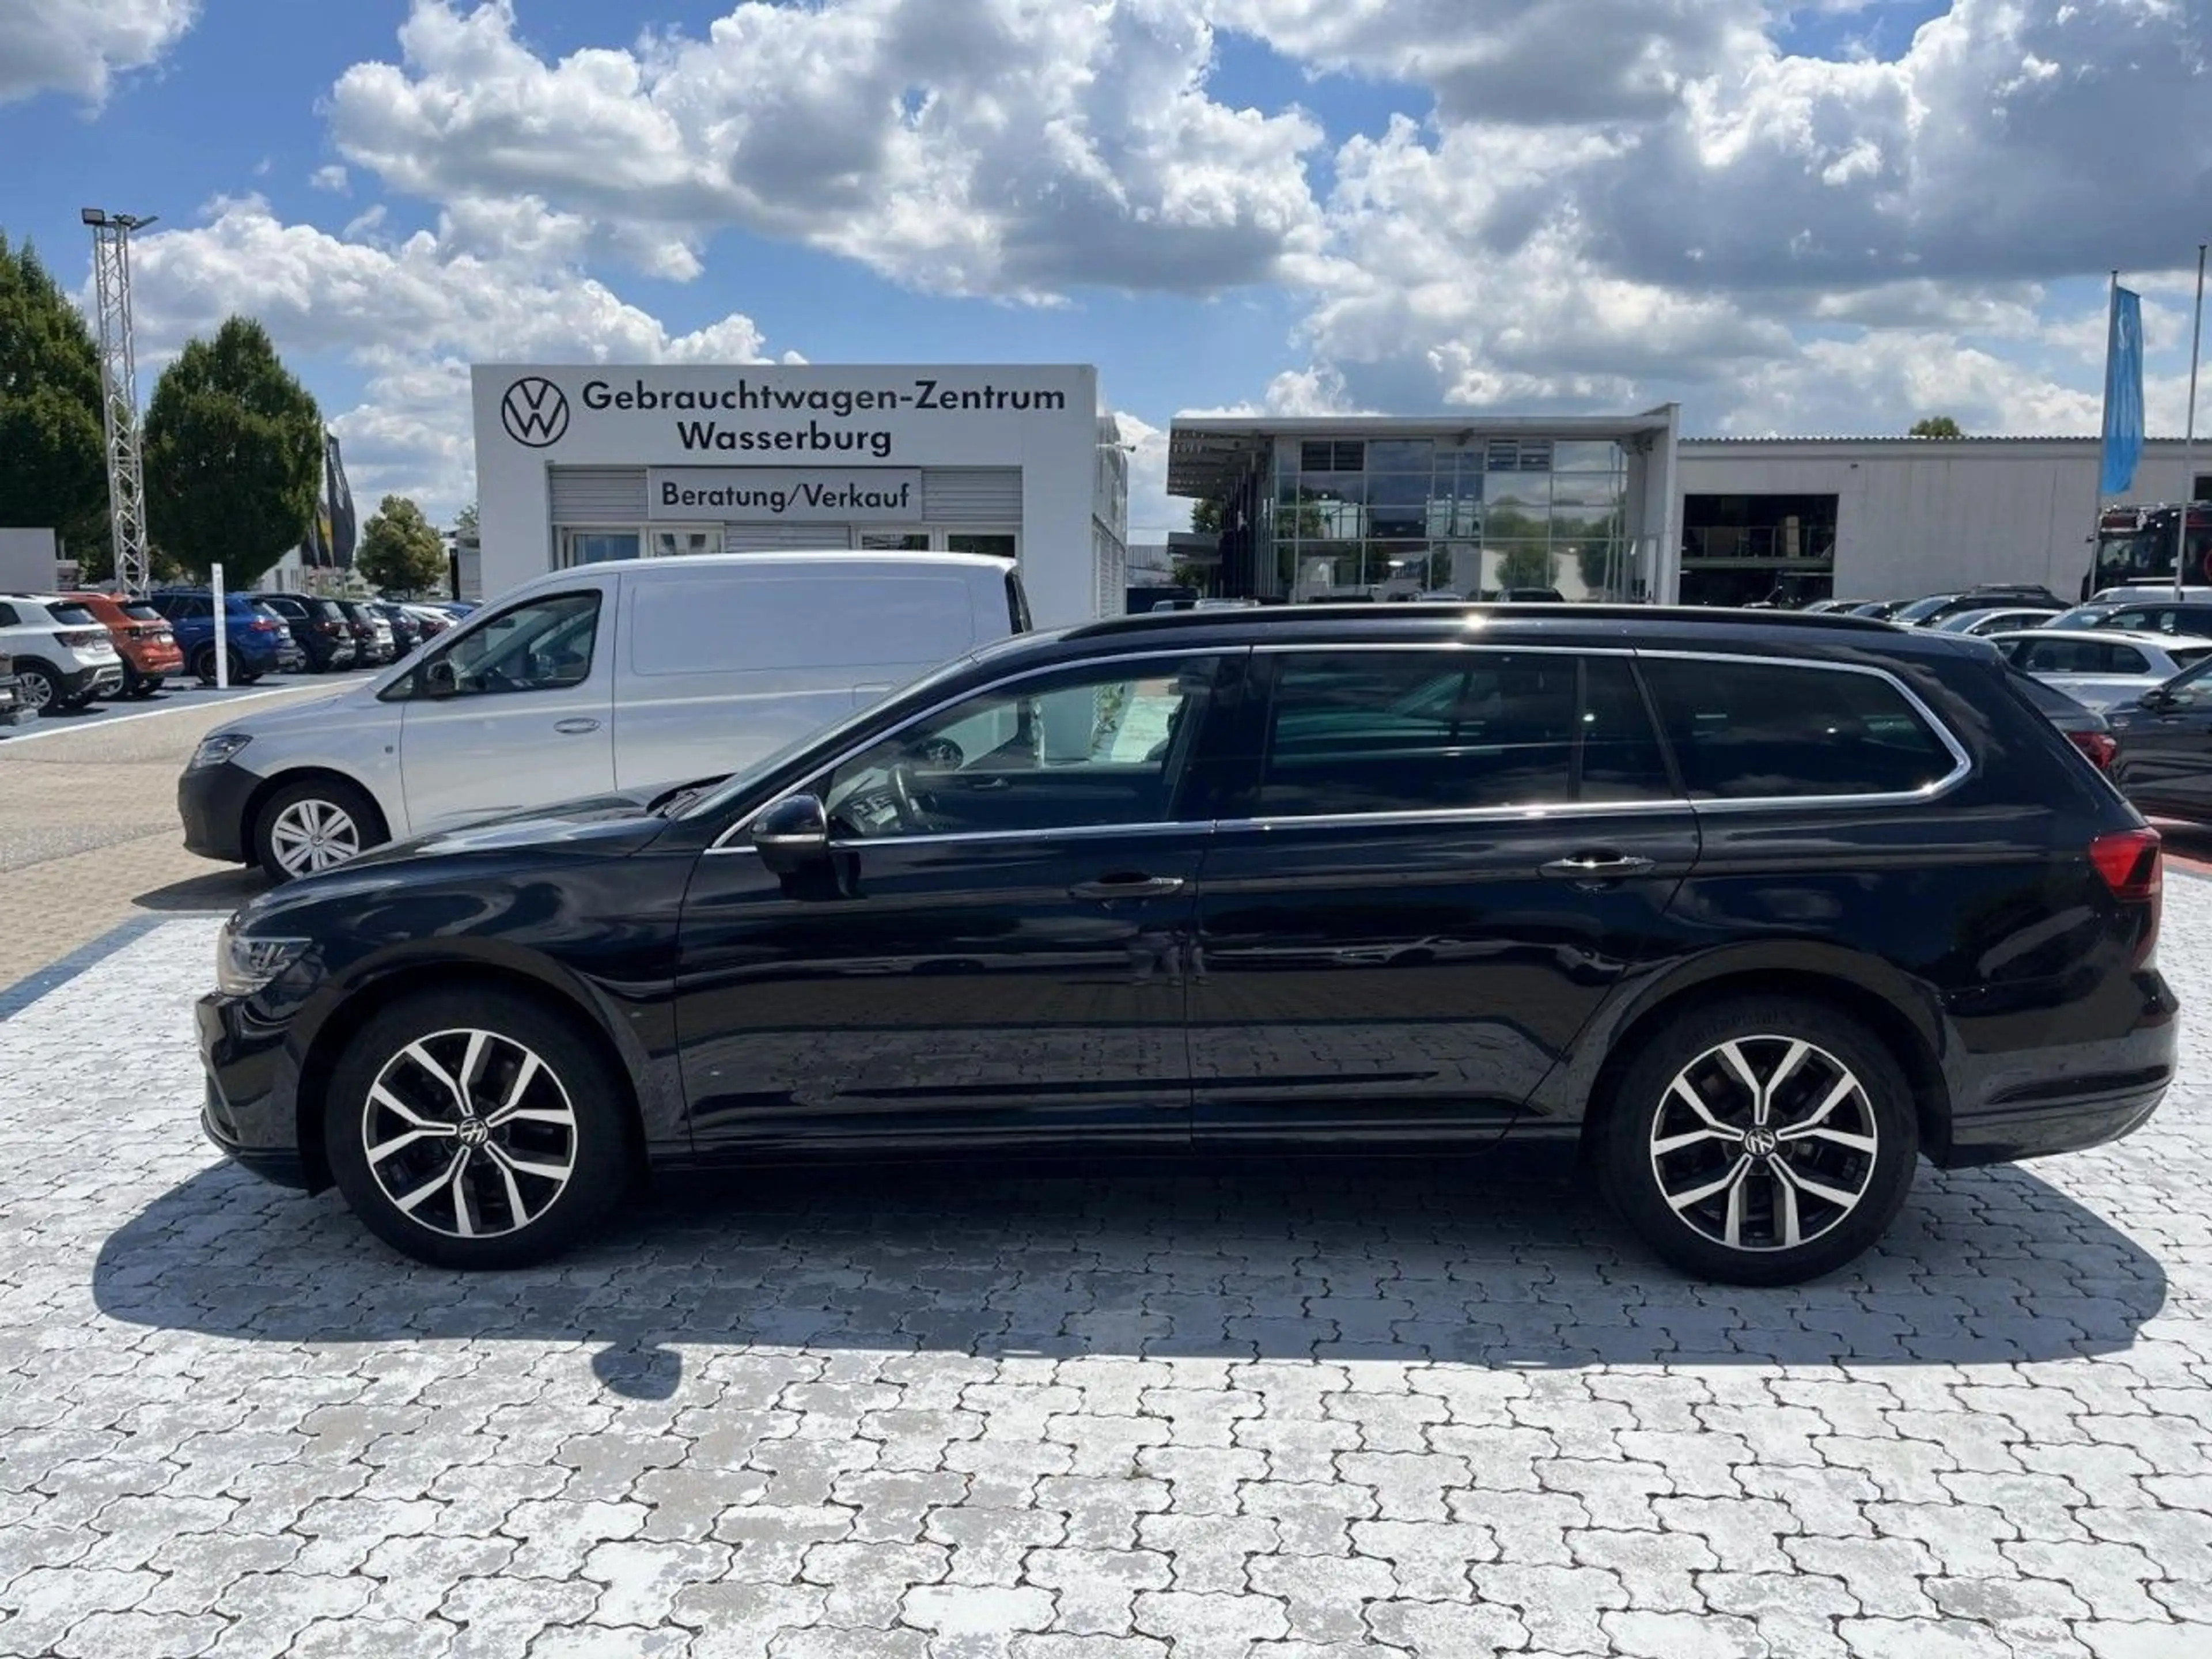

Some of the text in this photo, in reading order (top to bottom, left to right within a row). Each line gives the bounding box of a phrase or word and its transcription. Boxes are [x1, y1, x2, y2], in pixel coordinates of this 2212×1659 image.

[582, 378, 1065, 417] Gebrauchtwagen-Zentrum
[676, 419, 891, 458] Wasserburg
[661, 480, 911, 514] Beratung/Verkauf
